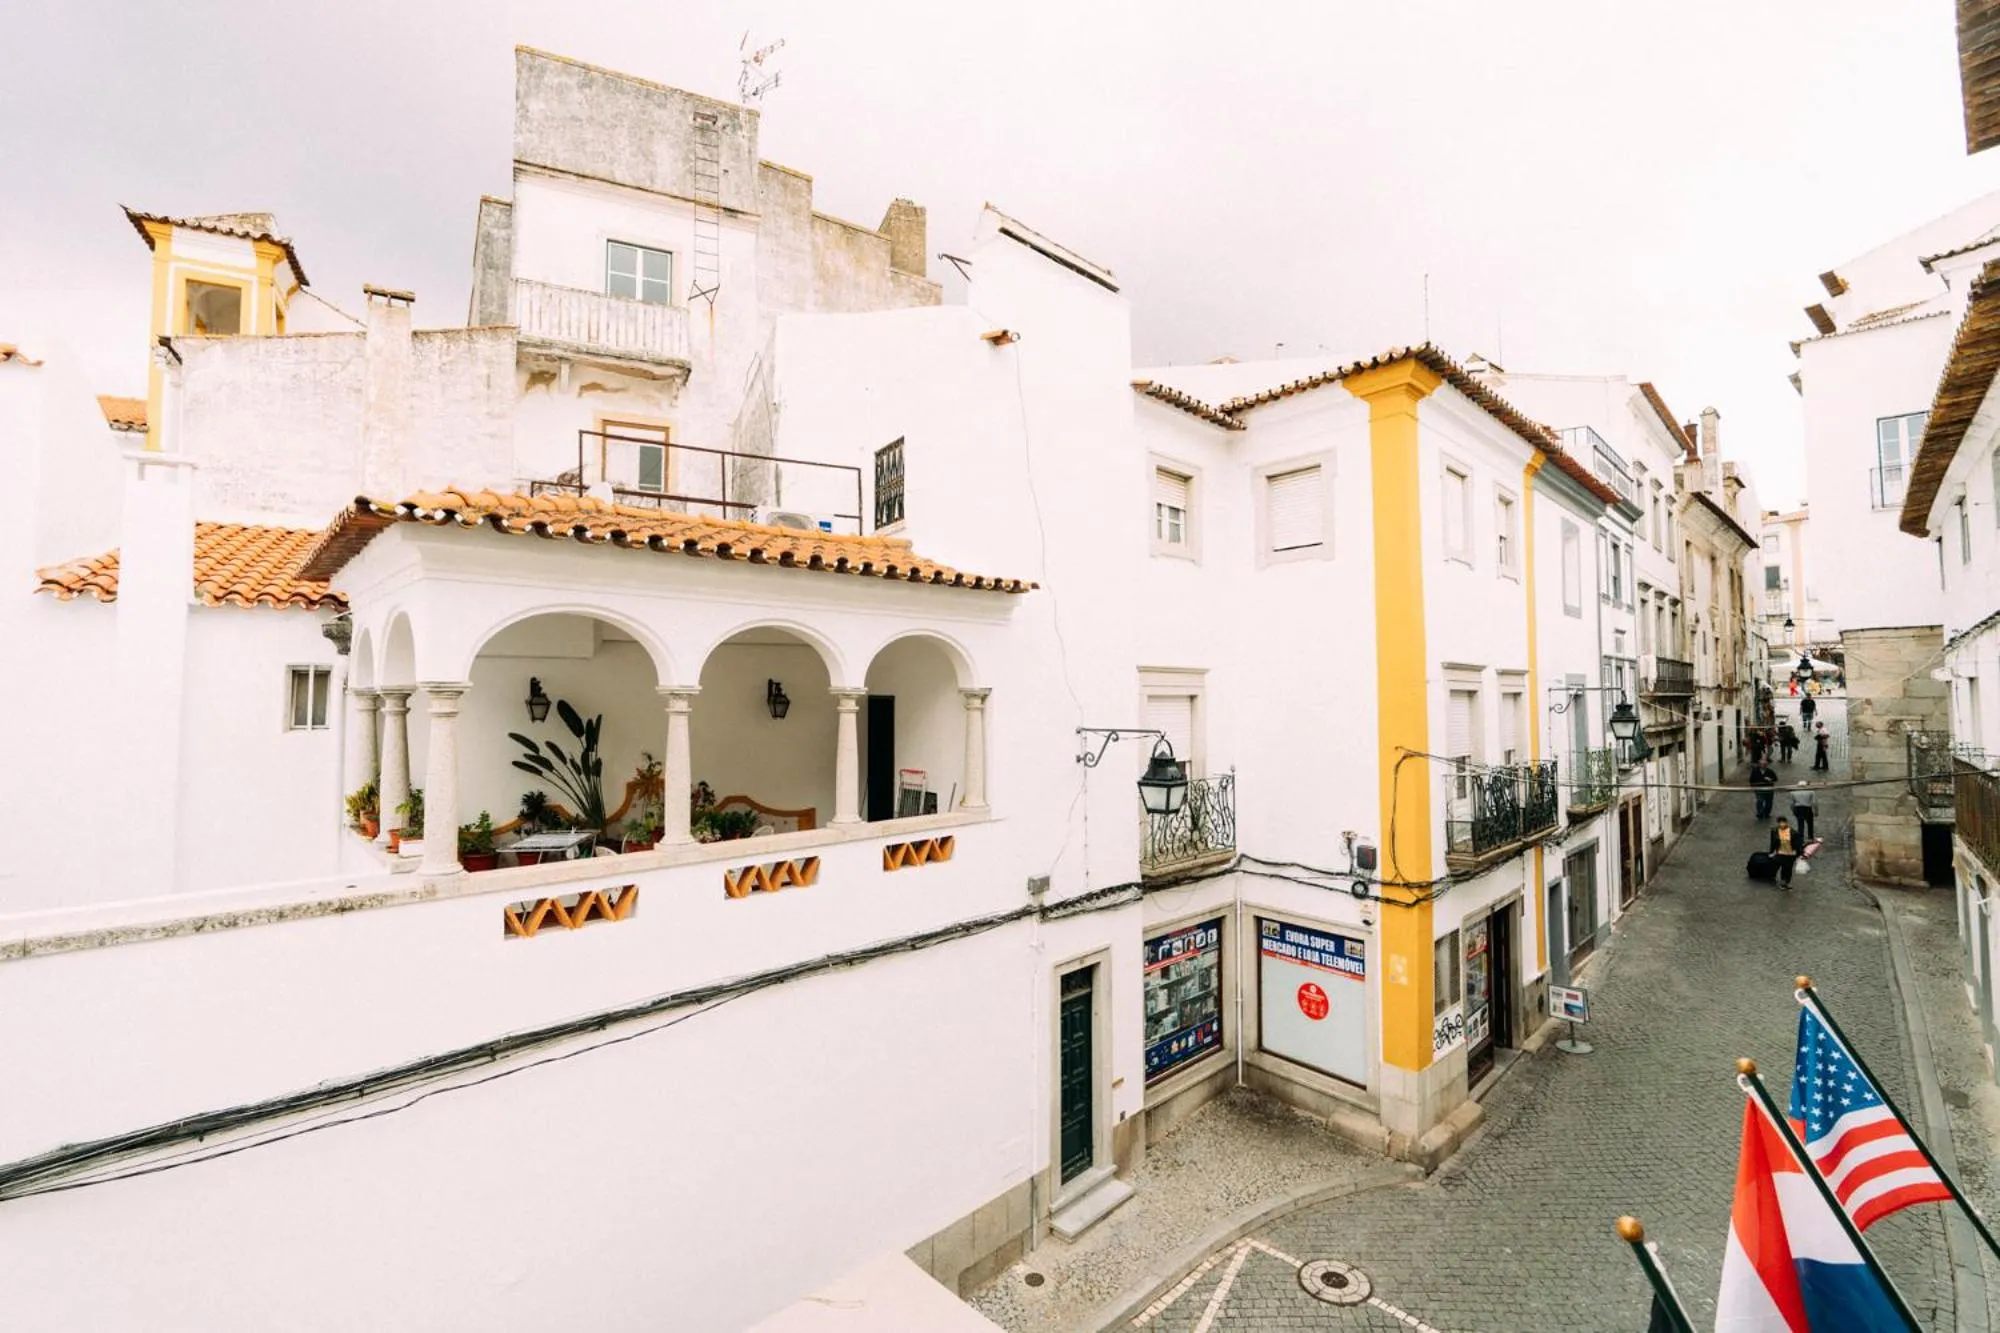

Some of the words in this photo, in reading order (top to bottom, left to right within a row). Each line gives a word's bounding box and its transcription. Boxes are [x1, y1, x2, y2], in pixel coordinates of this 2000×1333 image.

[1262, 938, 1297, 957] MERCADO
[1298, 947, 1302, 958] E
[1303, 948, 1321, 963] LOJA
[1321, 952, 1364, 975] TELEMÓVEL
[1310, 936, 1335, 952] SUPER
